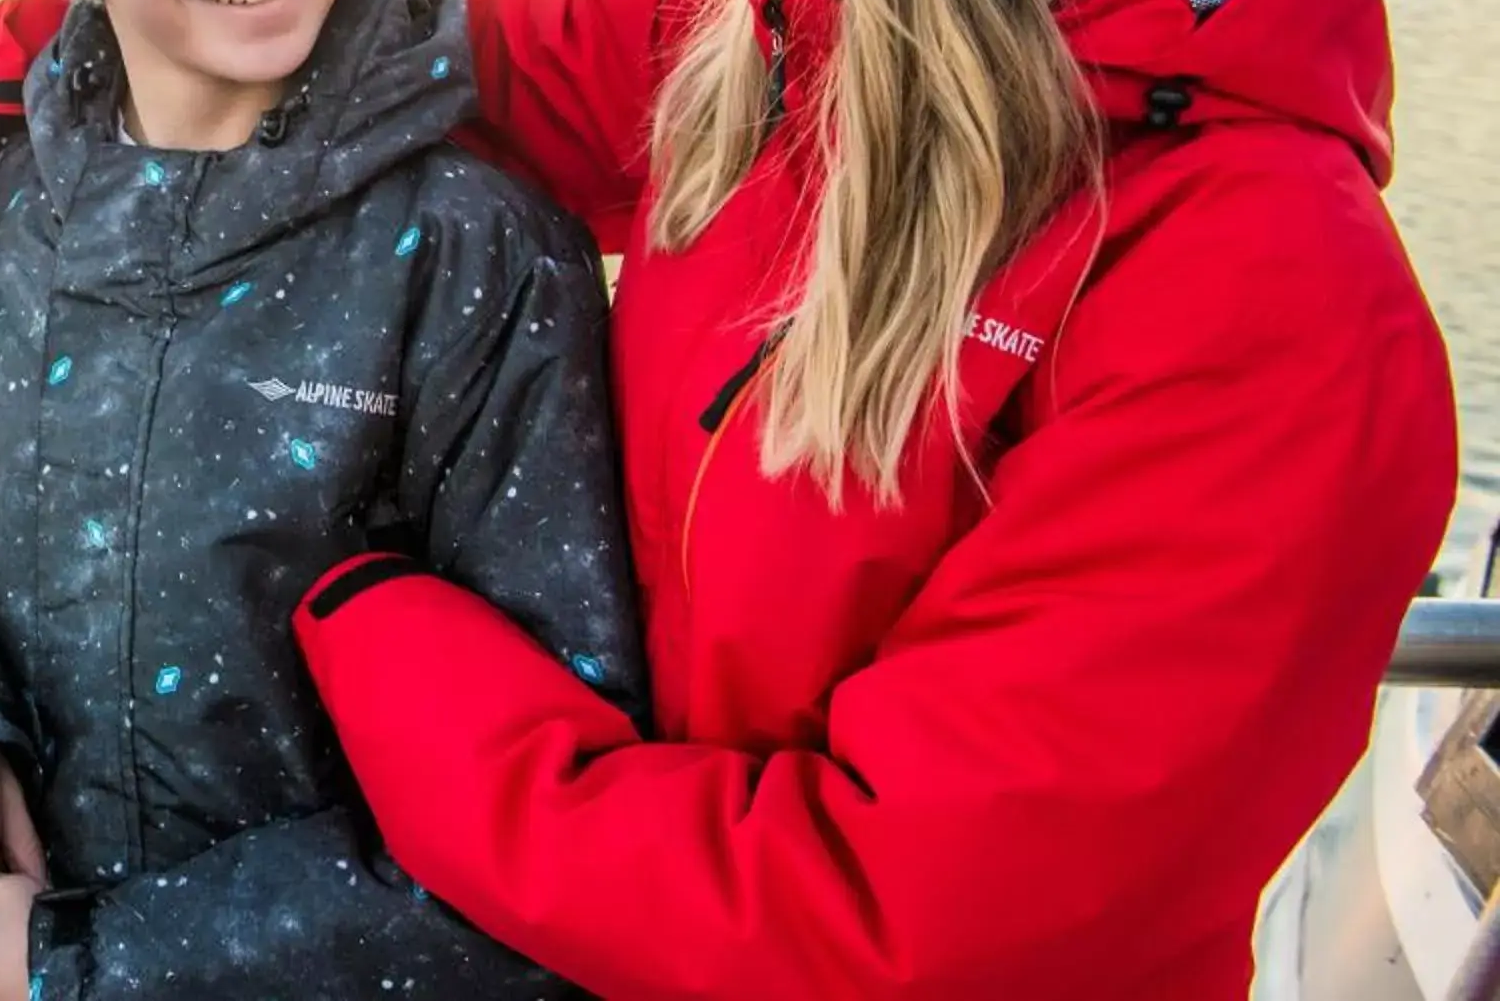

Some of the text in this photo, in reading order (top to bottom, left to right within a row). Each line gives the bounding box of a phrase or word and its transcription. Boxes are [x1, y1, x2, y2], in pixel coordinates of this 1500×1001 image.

[978, 317, 1045, 363] SKATE
[294, 379, 400, 417] ALPINE SKATE
